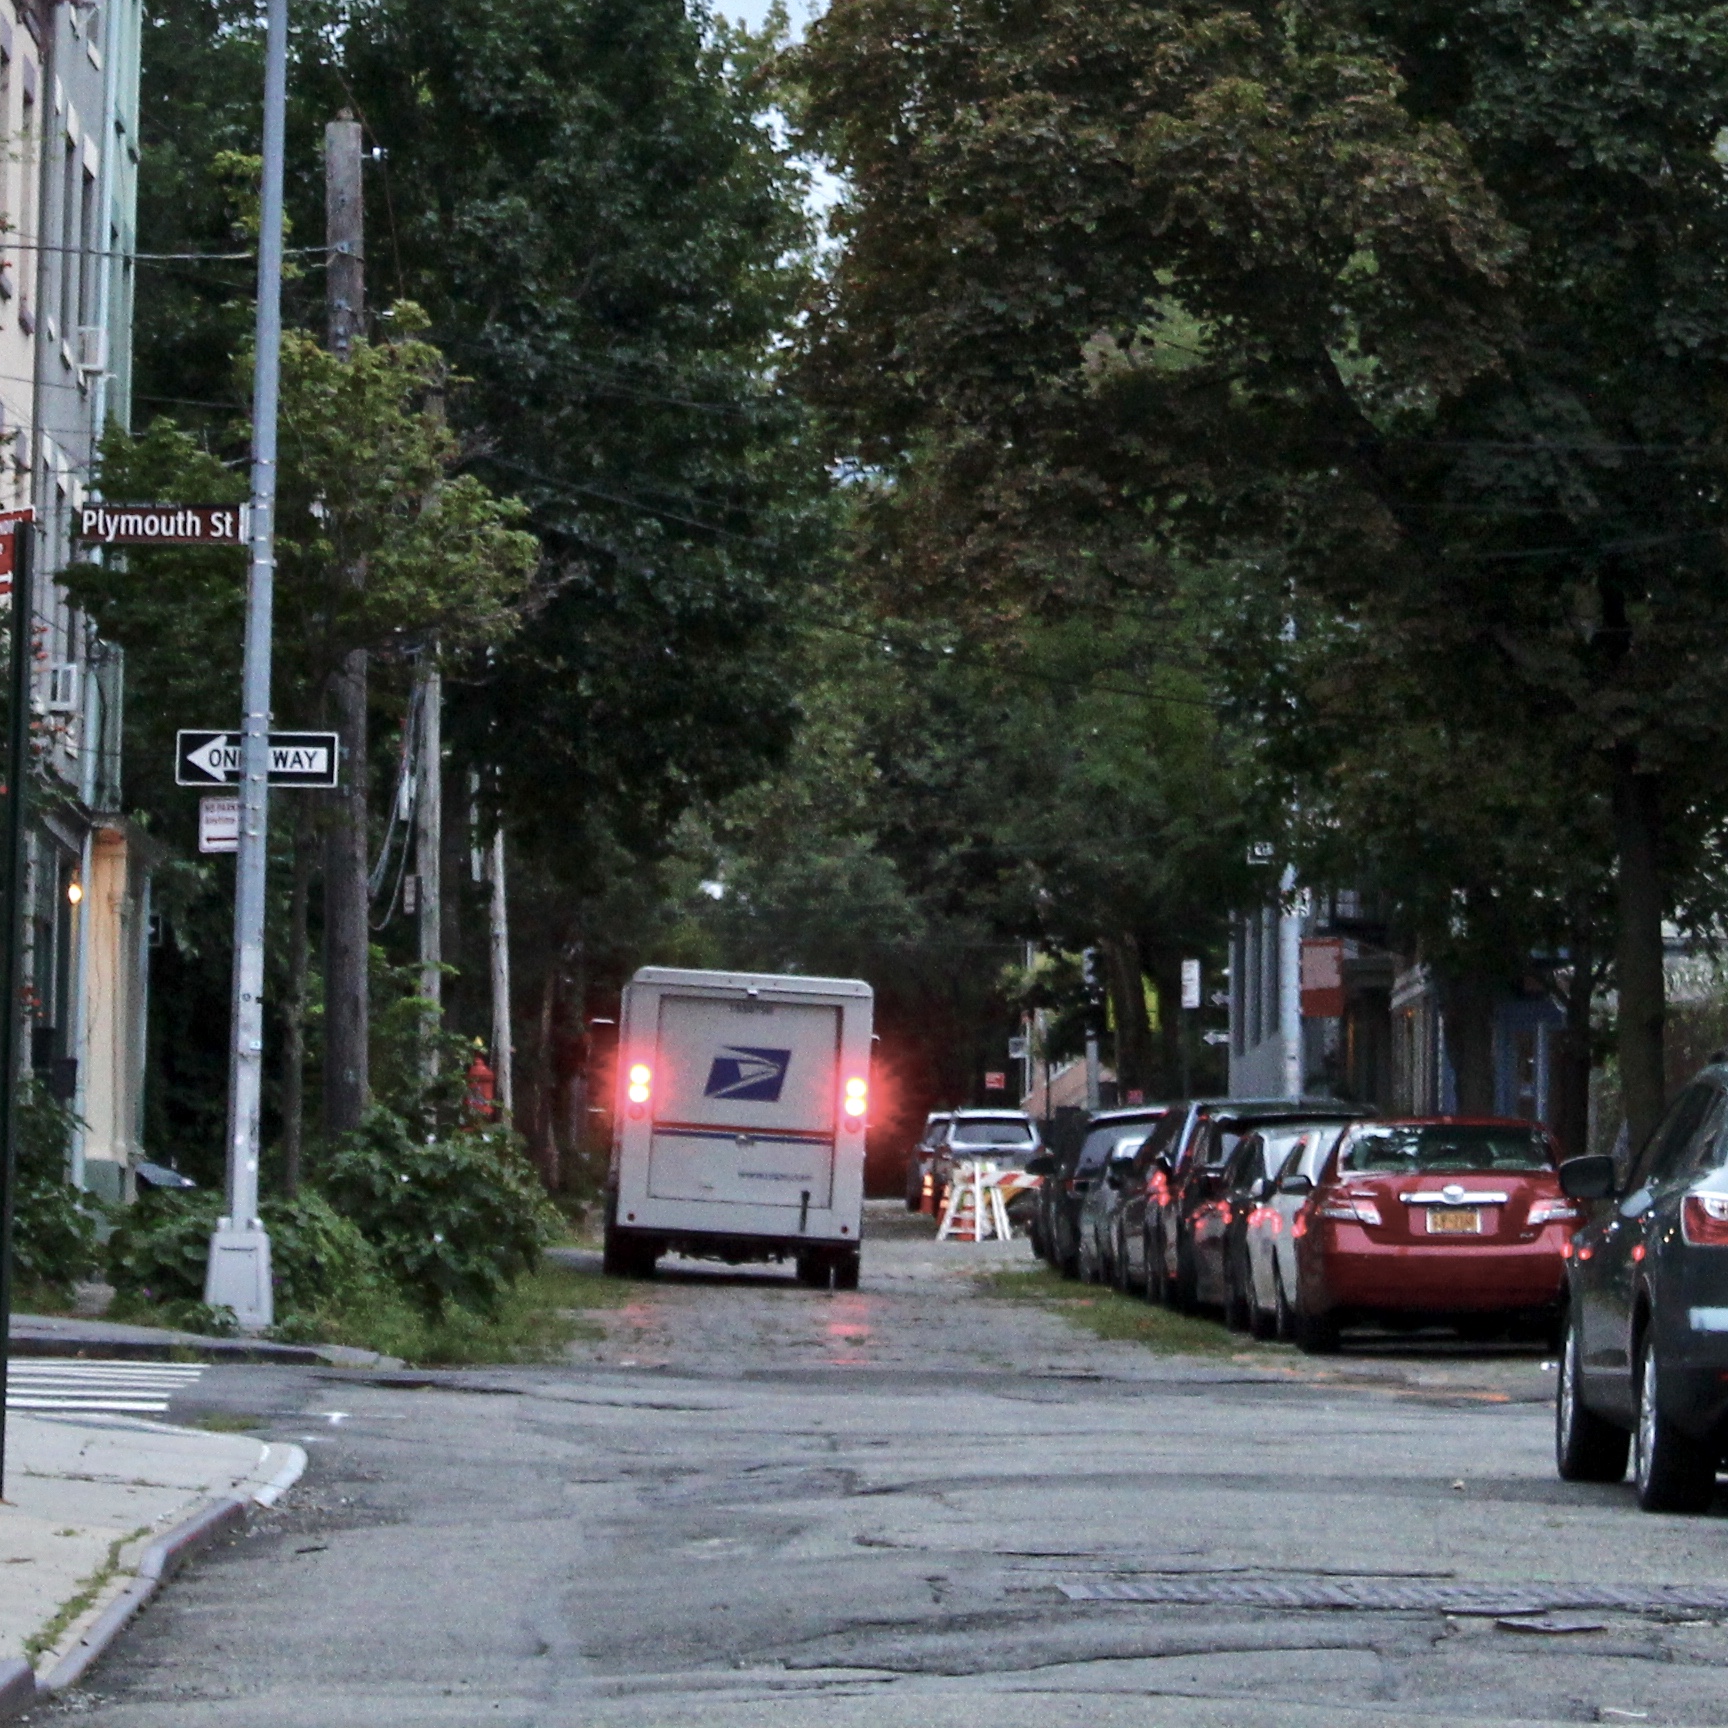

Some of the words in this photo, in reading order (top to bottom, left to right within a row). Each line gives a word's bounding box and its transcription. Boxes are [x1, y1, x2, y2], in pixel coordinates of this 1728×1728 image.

[82, 508, 201, 543] Plymouth
[209, 510, 234, 538] St
[208, 749, 242, 769] ON
[273, 750, 318, 770] WAY
